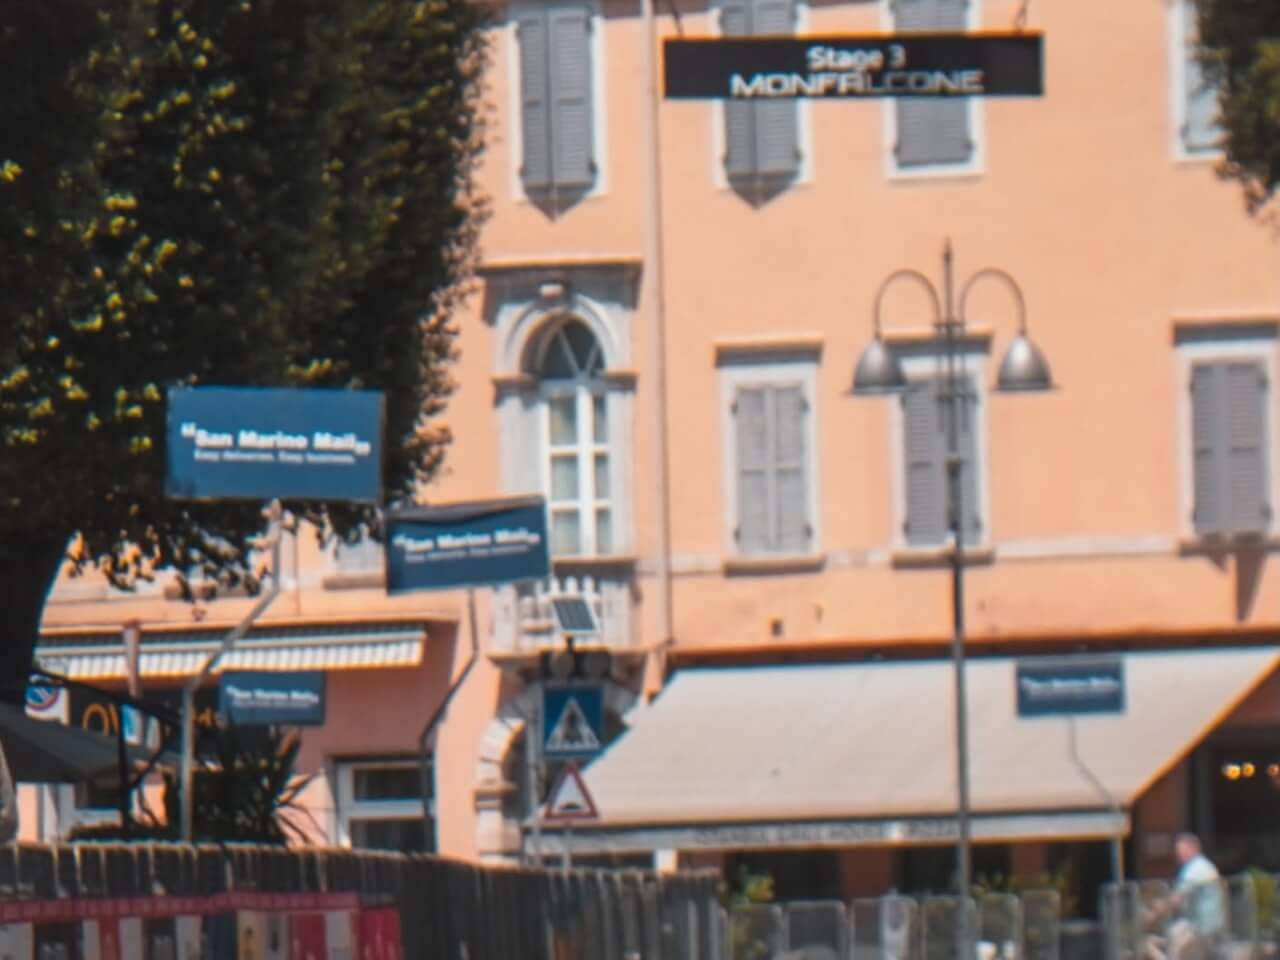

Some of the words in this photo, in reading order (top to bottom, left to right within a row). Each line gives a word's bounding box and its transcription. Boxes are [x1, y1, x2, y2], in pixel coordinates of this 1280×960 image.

[806, 45, 883, 72] Stage
[888, 45, 906, 67] 3
[729, 71, 984, 96] MONFALCONE
